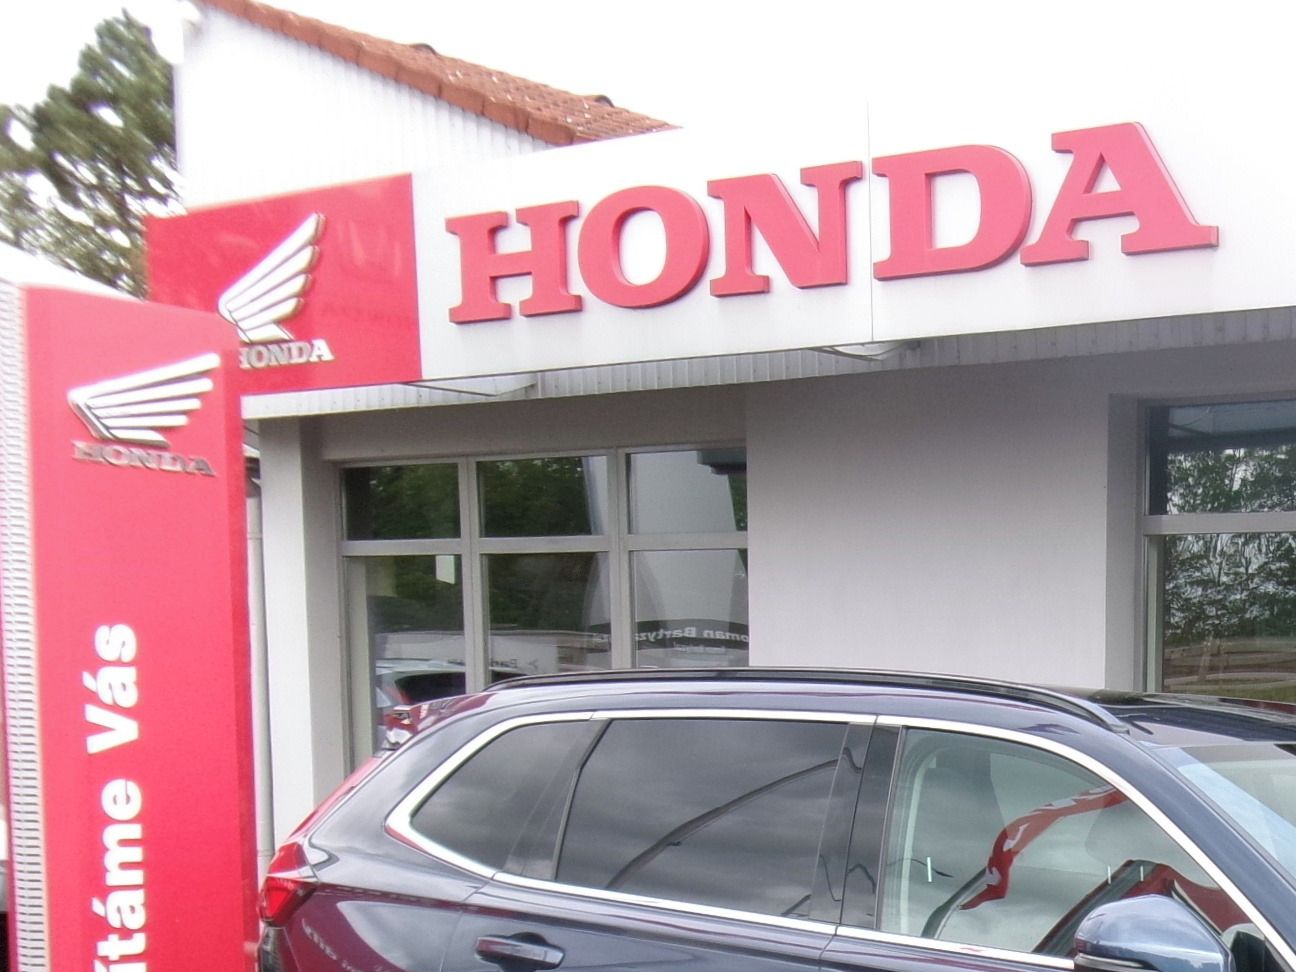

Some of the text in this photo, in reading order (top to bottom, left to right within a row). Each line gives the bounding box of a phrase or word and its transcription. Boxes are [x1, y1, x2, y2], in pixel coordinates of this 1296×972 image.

[445, 121, 1219, 324] HONDA
[71, 440, 217, 477] HONDA
[82, 623, 139, 754] Vás
